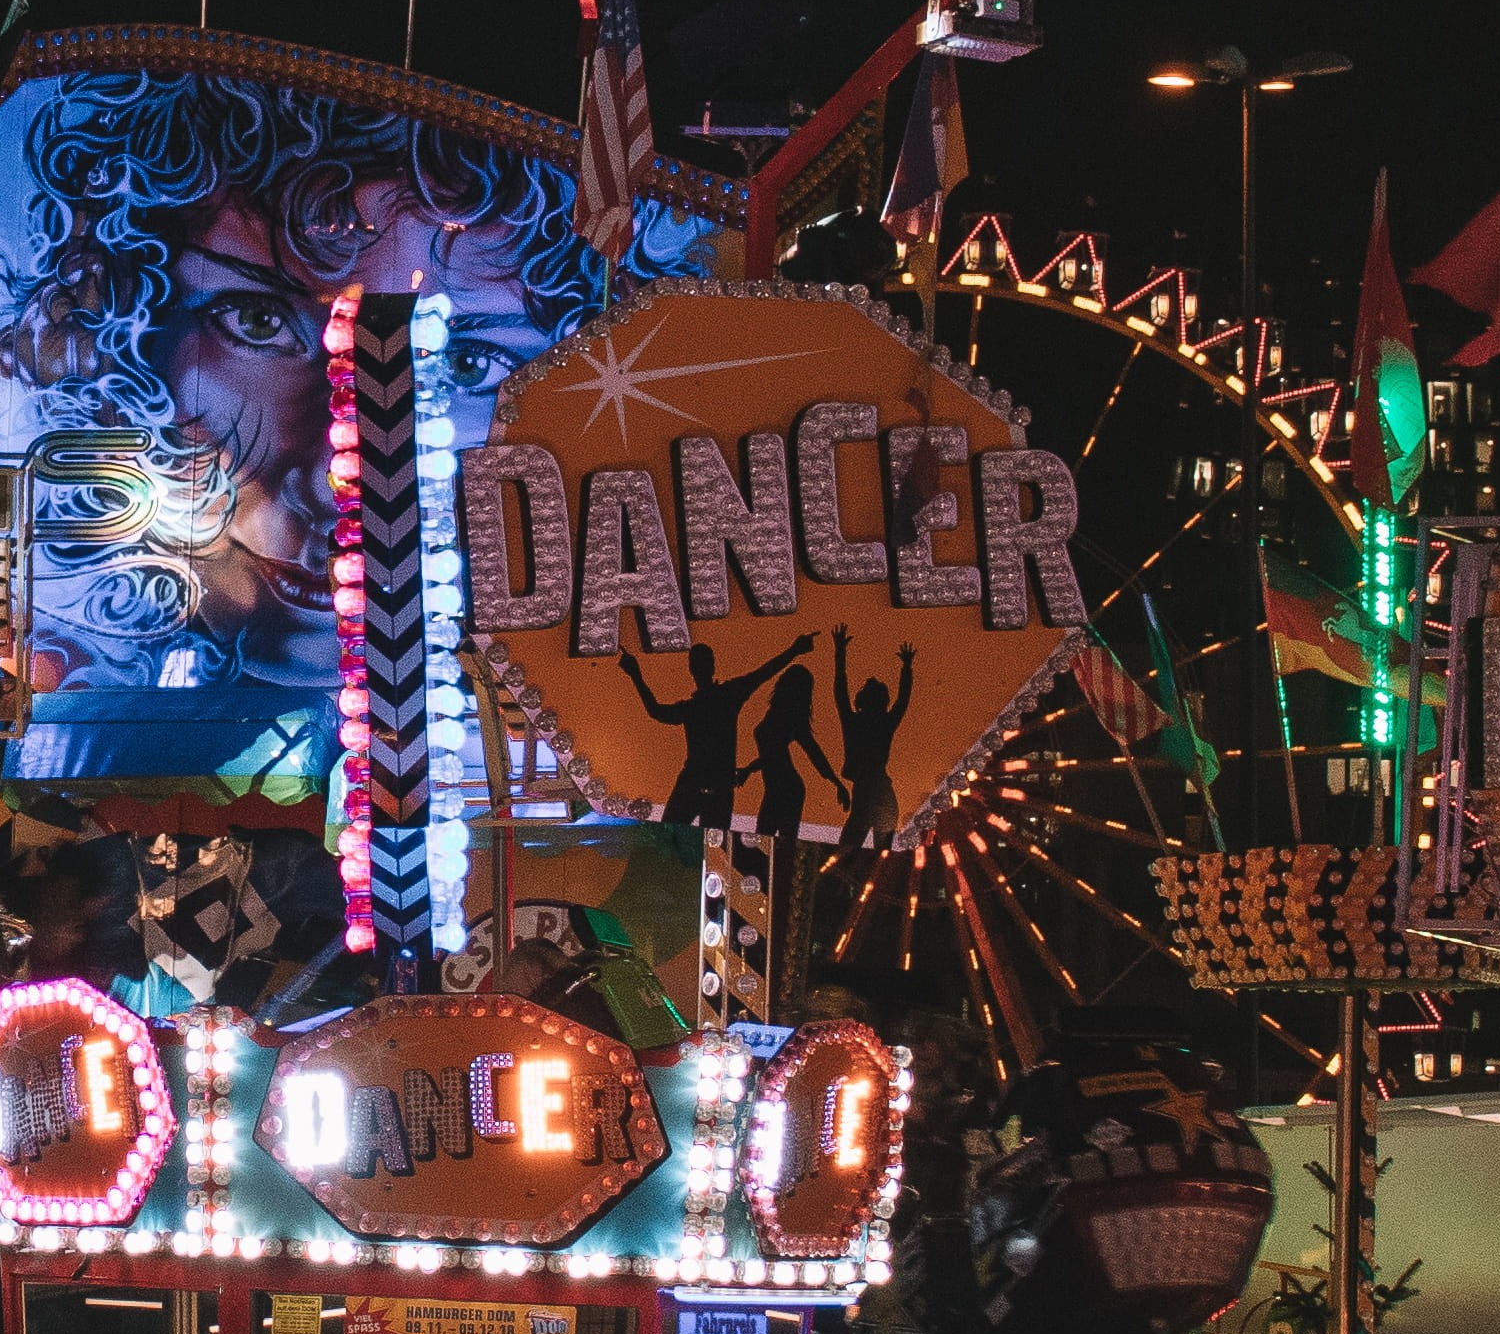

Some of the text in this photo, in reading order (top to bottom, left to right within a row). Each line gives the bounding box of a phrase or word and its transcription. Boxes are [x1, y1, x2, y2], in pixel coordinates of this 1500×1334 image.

[461, 402, 1090, 658] DANCER
[285, 1052, 637, 1177] DANCER
[347, 1322, 382, 1334] SPASS
[406, 1307, 484, 1322] HAMBURGER
[487, 1310, 516, 1323] DOM
